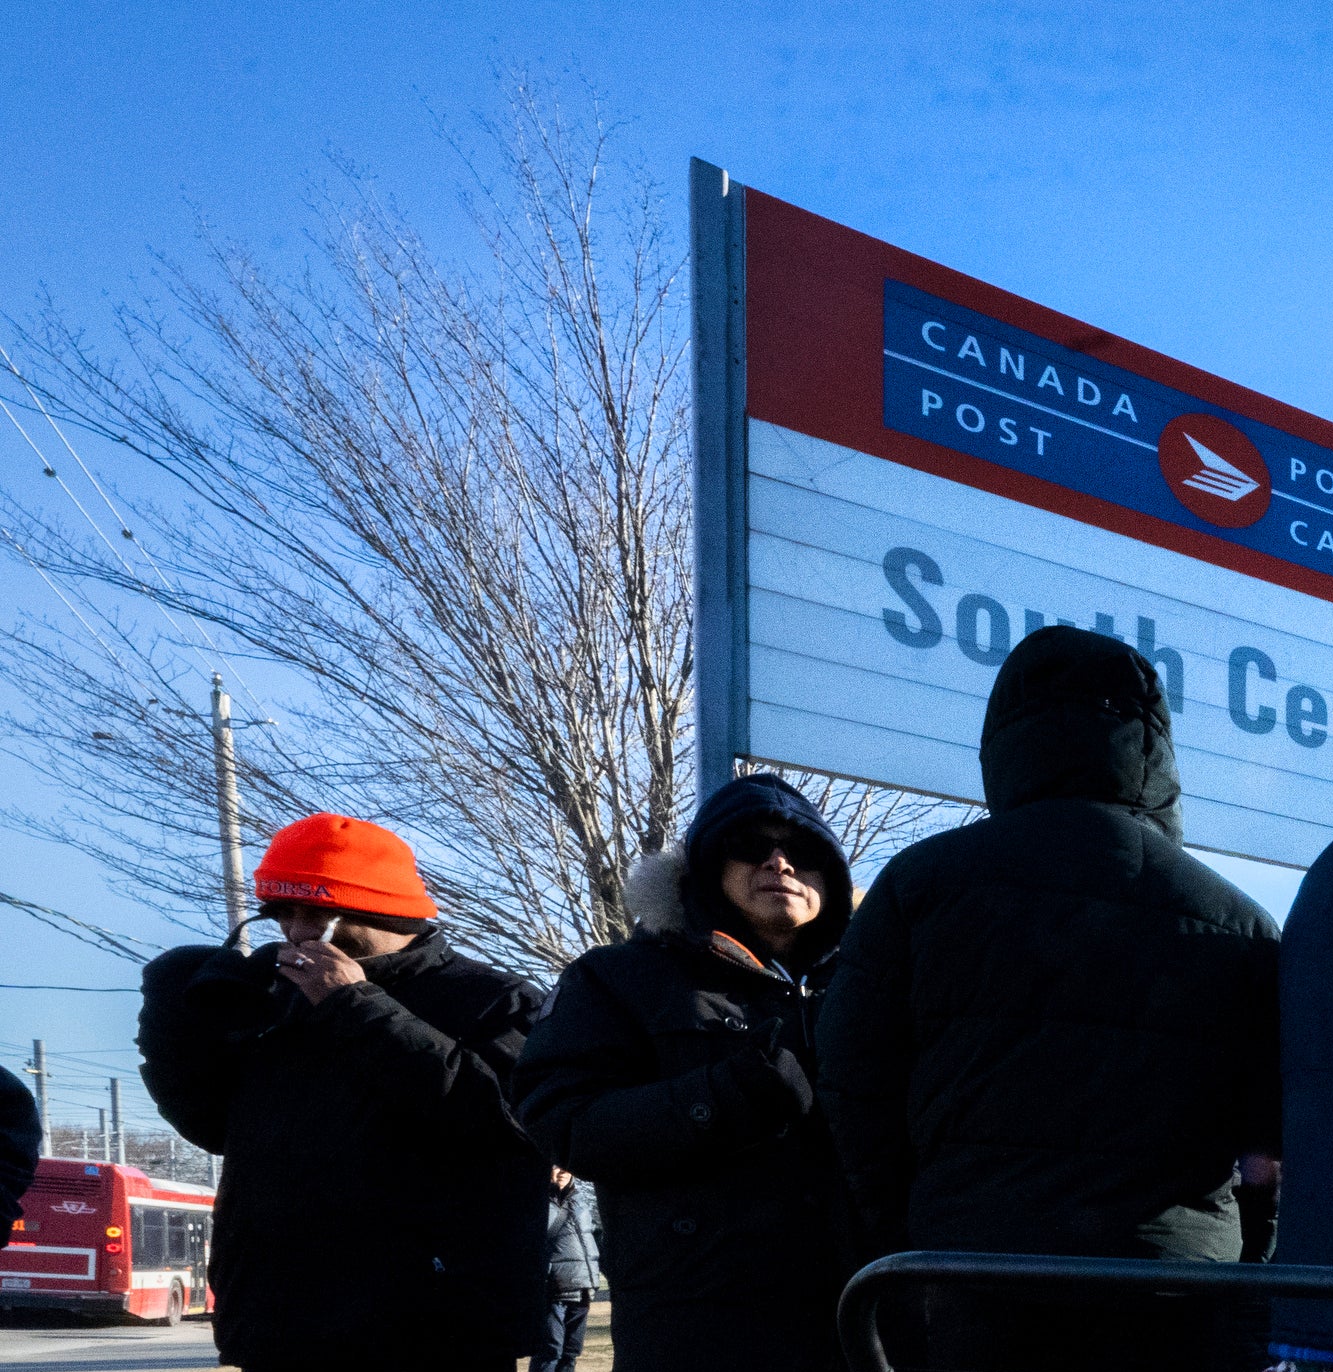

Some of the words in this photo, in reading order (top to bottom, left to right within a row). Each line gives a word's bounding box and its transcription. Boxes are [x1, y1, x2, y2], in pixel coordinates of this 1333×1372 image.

[921, 320, 1139, 424] CANADA
[922, 388, 1052, 457] POST
[882, 546, 1184, 714] Soh
